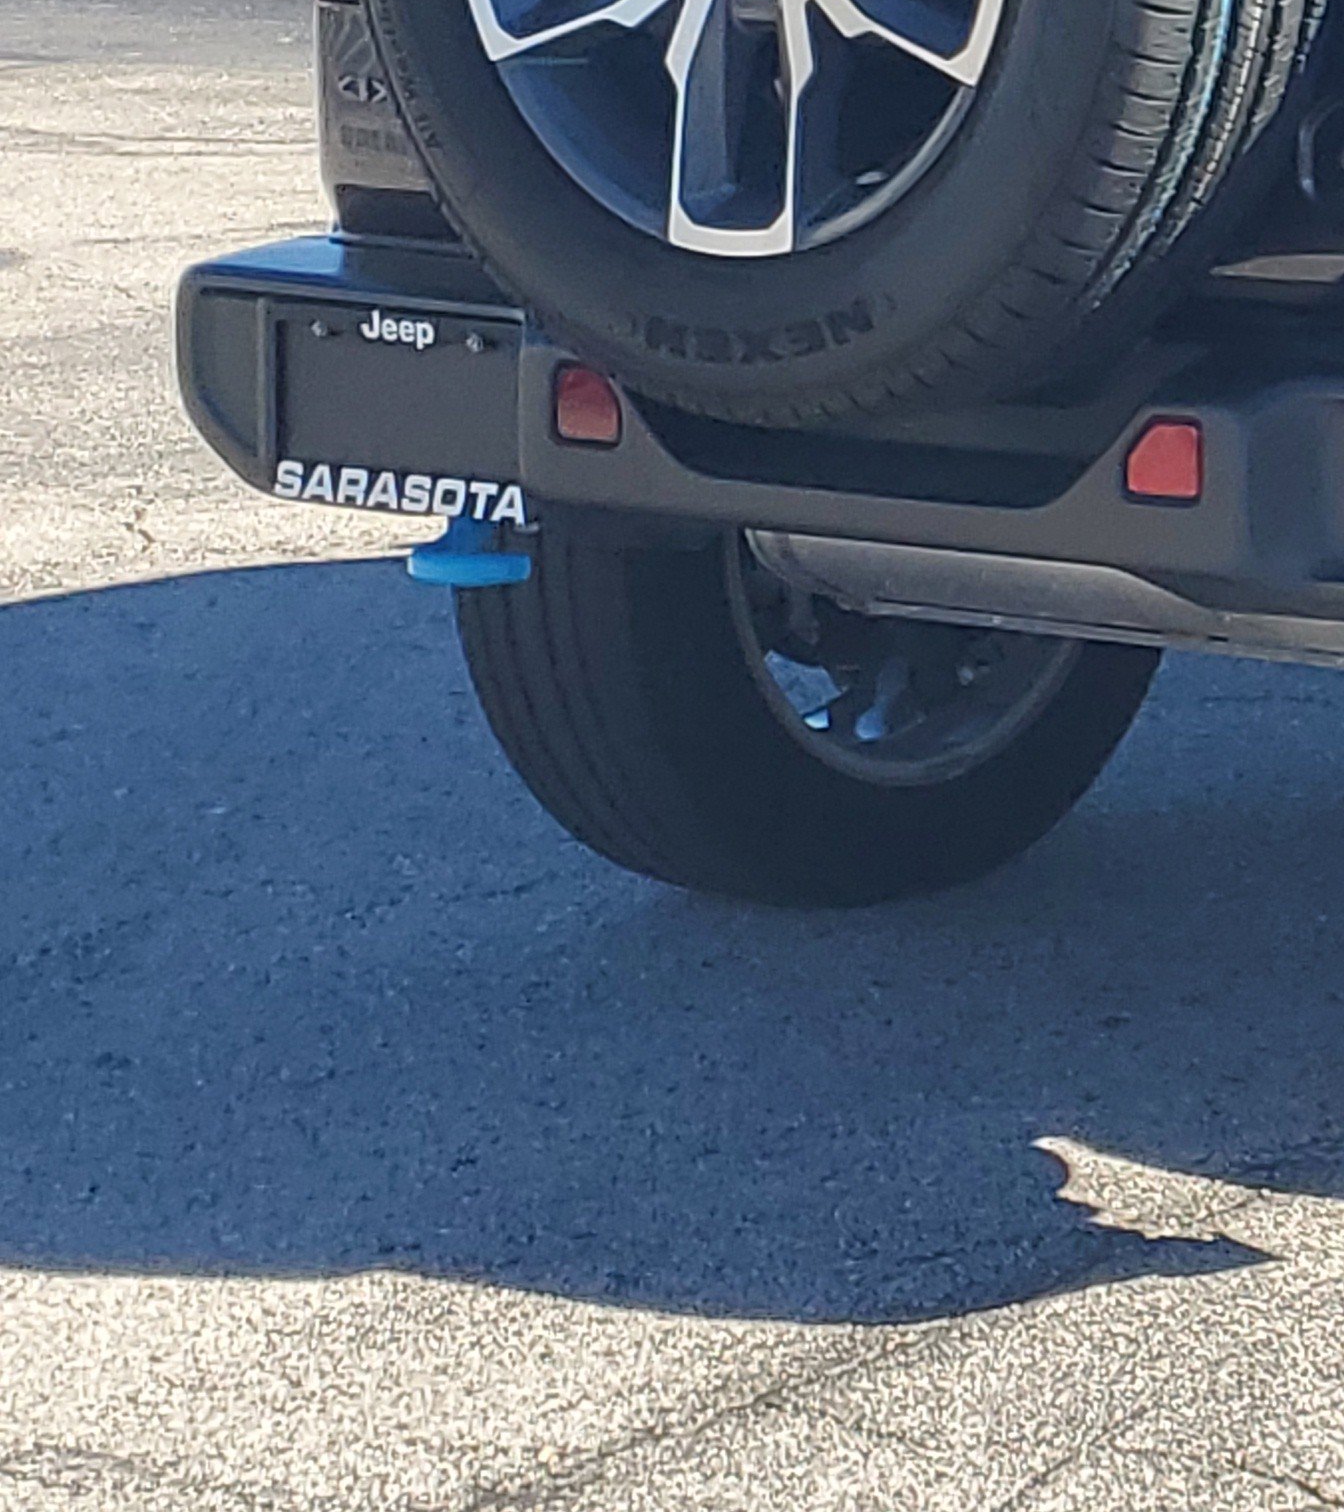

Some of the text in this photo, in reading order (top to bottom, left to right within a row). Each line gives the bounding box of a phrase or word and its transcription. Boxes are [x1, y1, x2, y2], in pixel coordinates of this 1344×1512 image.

[360, 310, 436, 350] Jeep
[645, 297, 875, 366] NEXEN
[274, 459, 526, 526] SARASOTA
